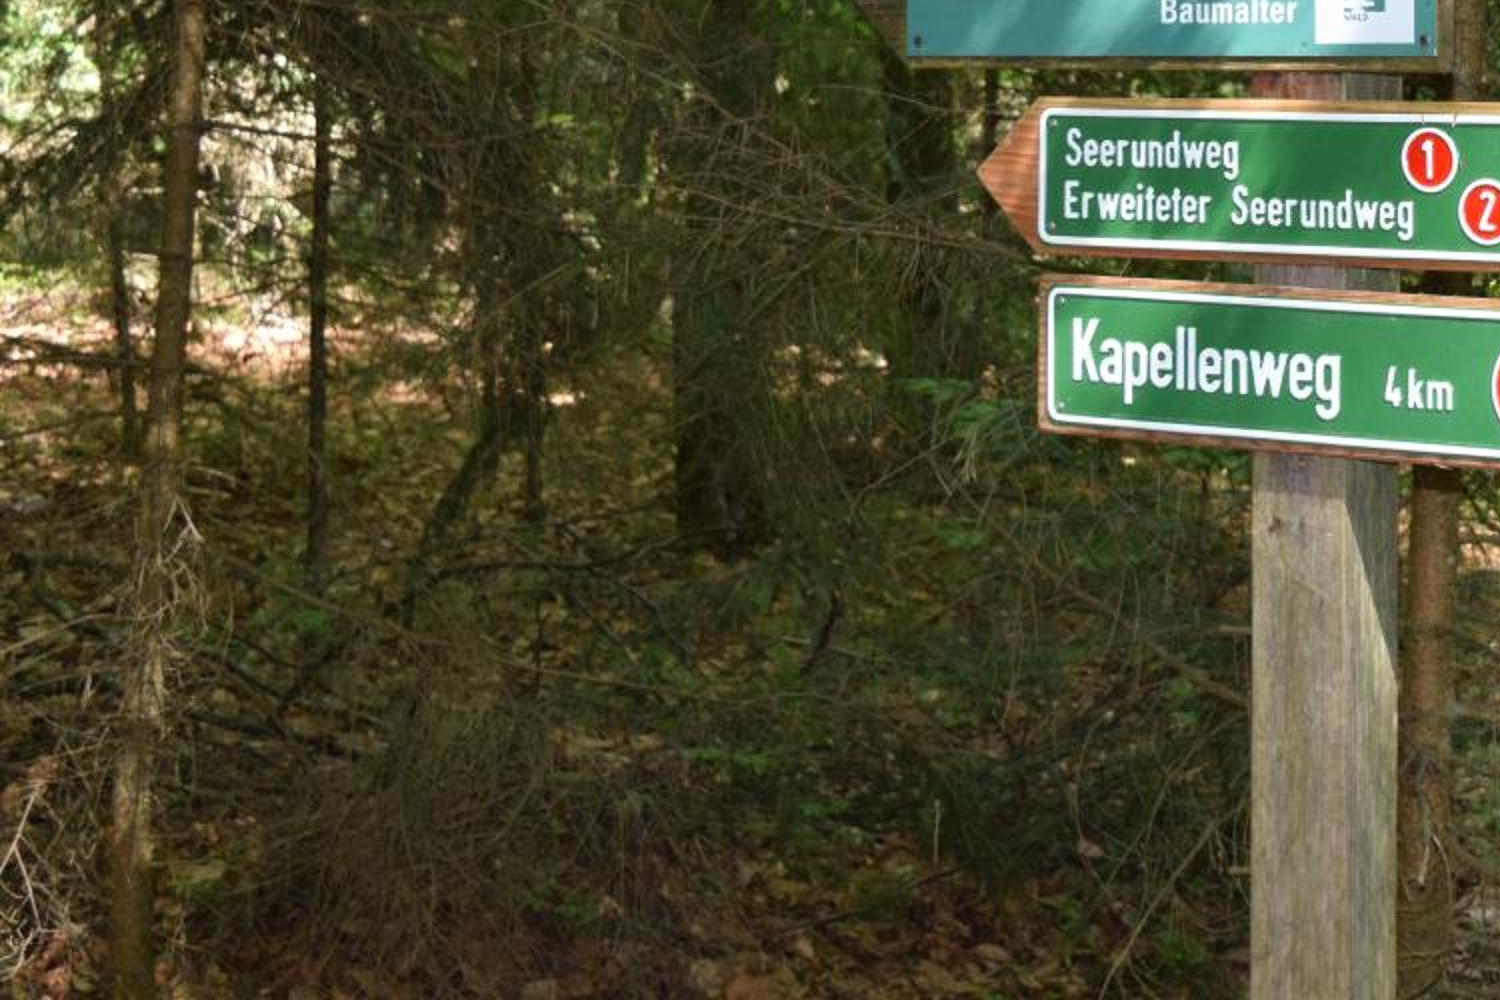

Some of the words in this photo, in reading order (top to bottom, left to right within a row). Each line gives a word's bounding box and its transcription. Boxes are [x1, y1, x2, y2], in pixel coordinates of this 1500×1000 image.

[1065, 127, 1239, 180] Seerundweg
[1421, 139, 1436, 181] 1
[1063, 179, 1213, 224] Erweiteter
[1230, 184, 1416, 239] Seerundweg
[1477, 192, 1495, 232] 2
[1071, 317, 1342, 421] Kapellenweg
